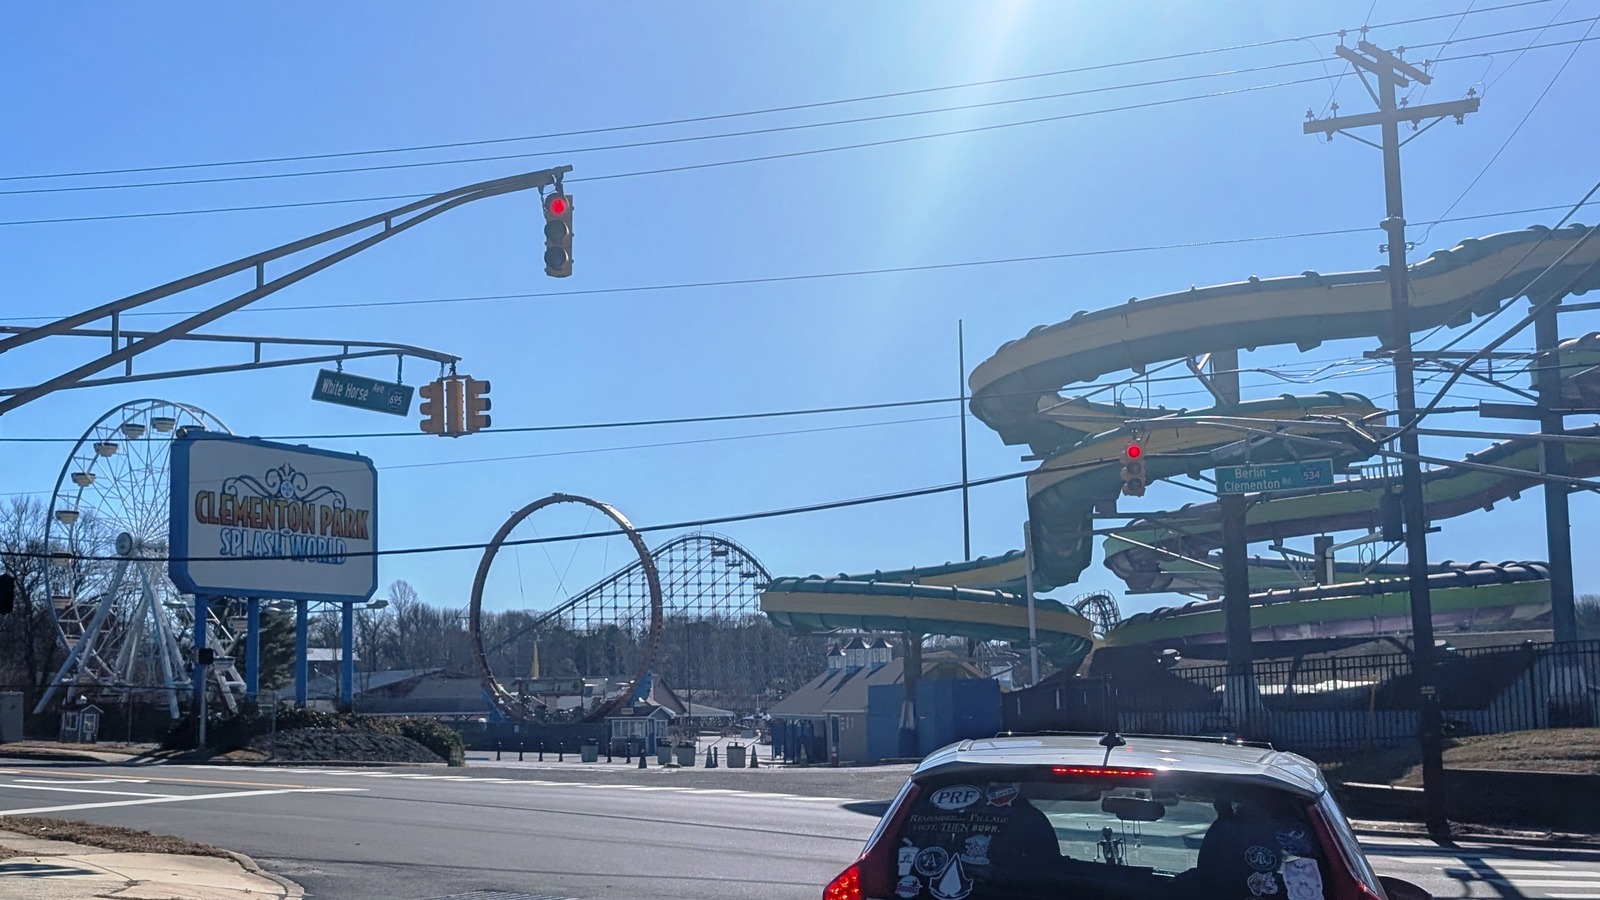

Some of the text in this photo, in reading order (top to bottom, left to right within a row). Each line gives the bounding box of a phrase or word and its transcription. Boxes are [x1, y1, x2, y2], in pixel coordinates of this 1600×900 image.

[322, 378, 385, 400] White Horse Ave
[389, 394, 402, 405] 695
[1234, 468, 1266, 479] Berlin
[1303, 471, 1320, 480] 534
[1224, 479, 1280, 492] Clementon
[195, 490, 369, 540] CLEMENTON PARK
[220, 528, 347, 564] SPLASH WORLD
[937, 790, 976, 804] PRF
